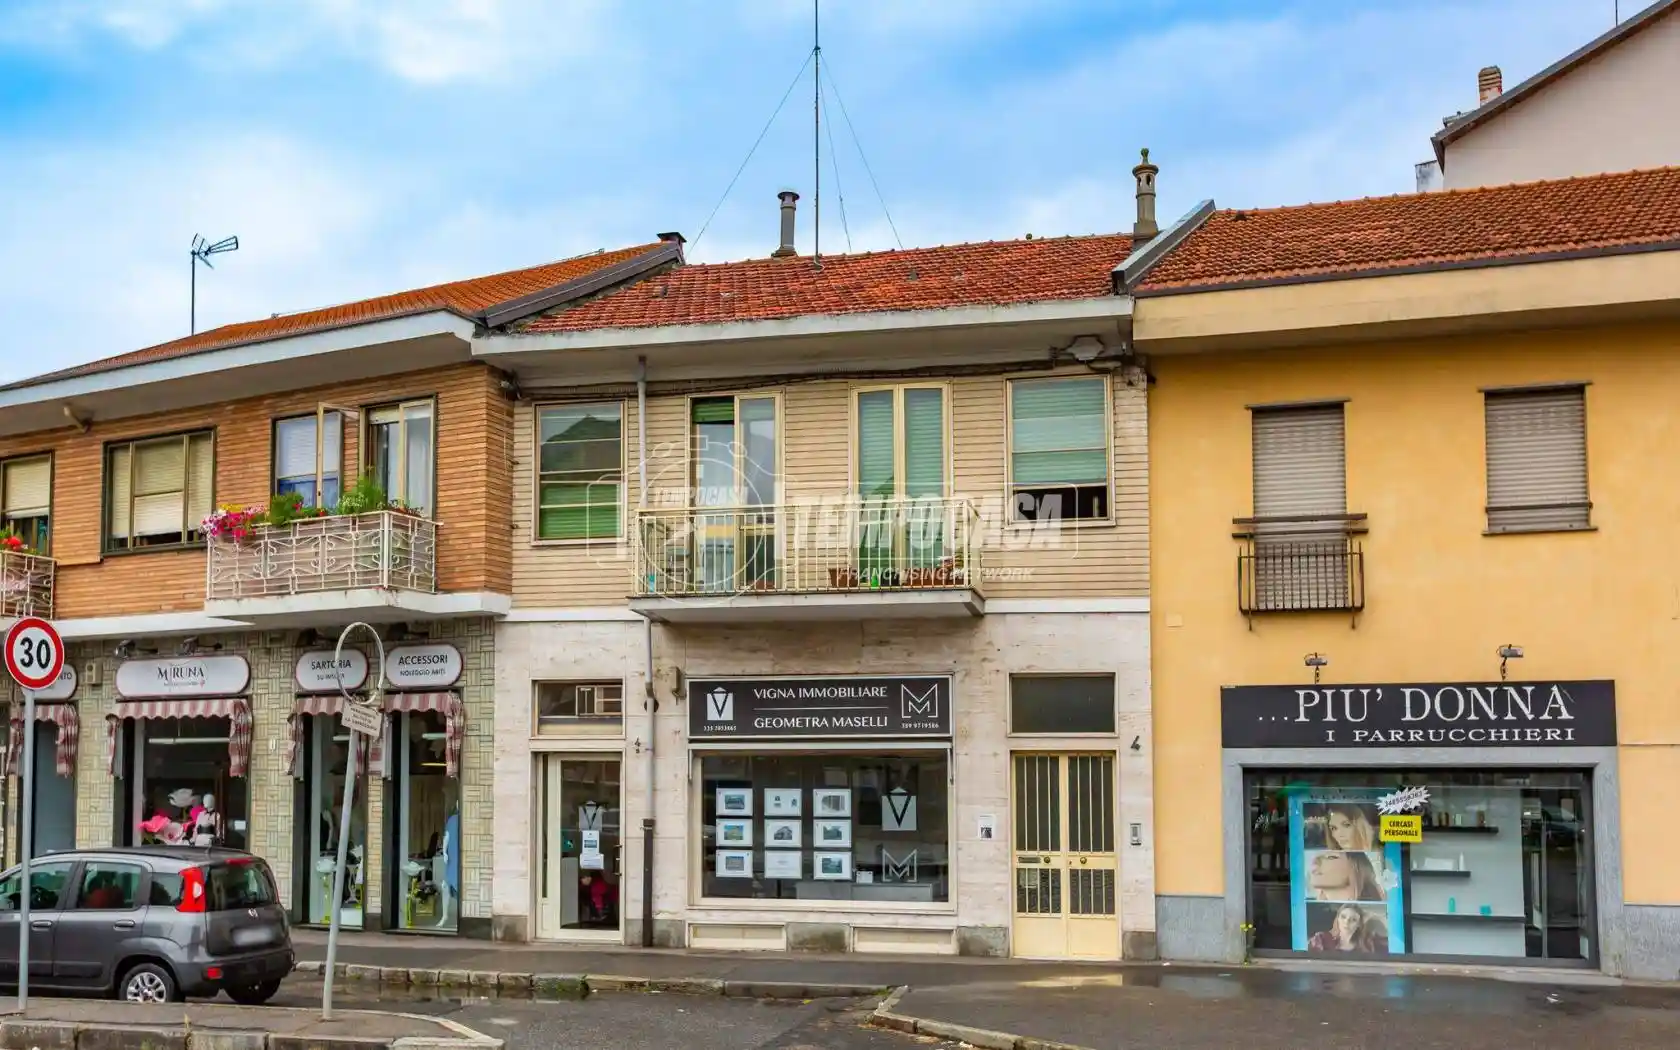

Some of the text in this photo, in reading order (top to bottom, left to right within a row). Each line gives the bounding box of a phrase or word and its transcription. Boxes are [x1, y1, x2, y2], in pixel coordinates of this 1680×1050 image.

[20, 637, 51, 669] 30
[398, 654, 448, 665] ACCESSORI
[753, 686, 888, 699] VIGNA IMMOBILIARE
[1400, 684, 1575, 722] DONNA
[753, 716, 888, 728] GEOMETRA MASELLI
[1326, 727, 1576, 742] I PARRUCCHIERI
[1389, 820, 1414, 828] CERCASI
[1384, 829, 1418, 837] PERSONALE
